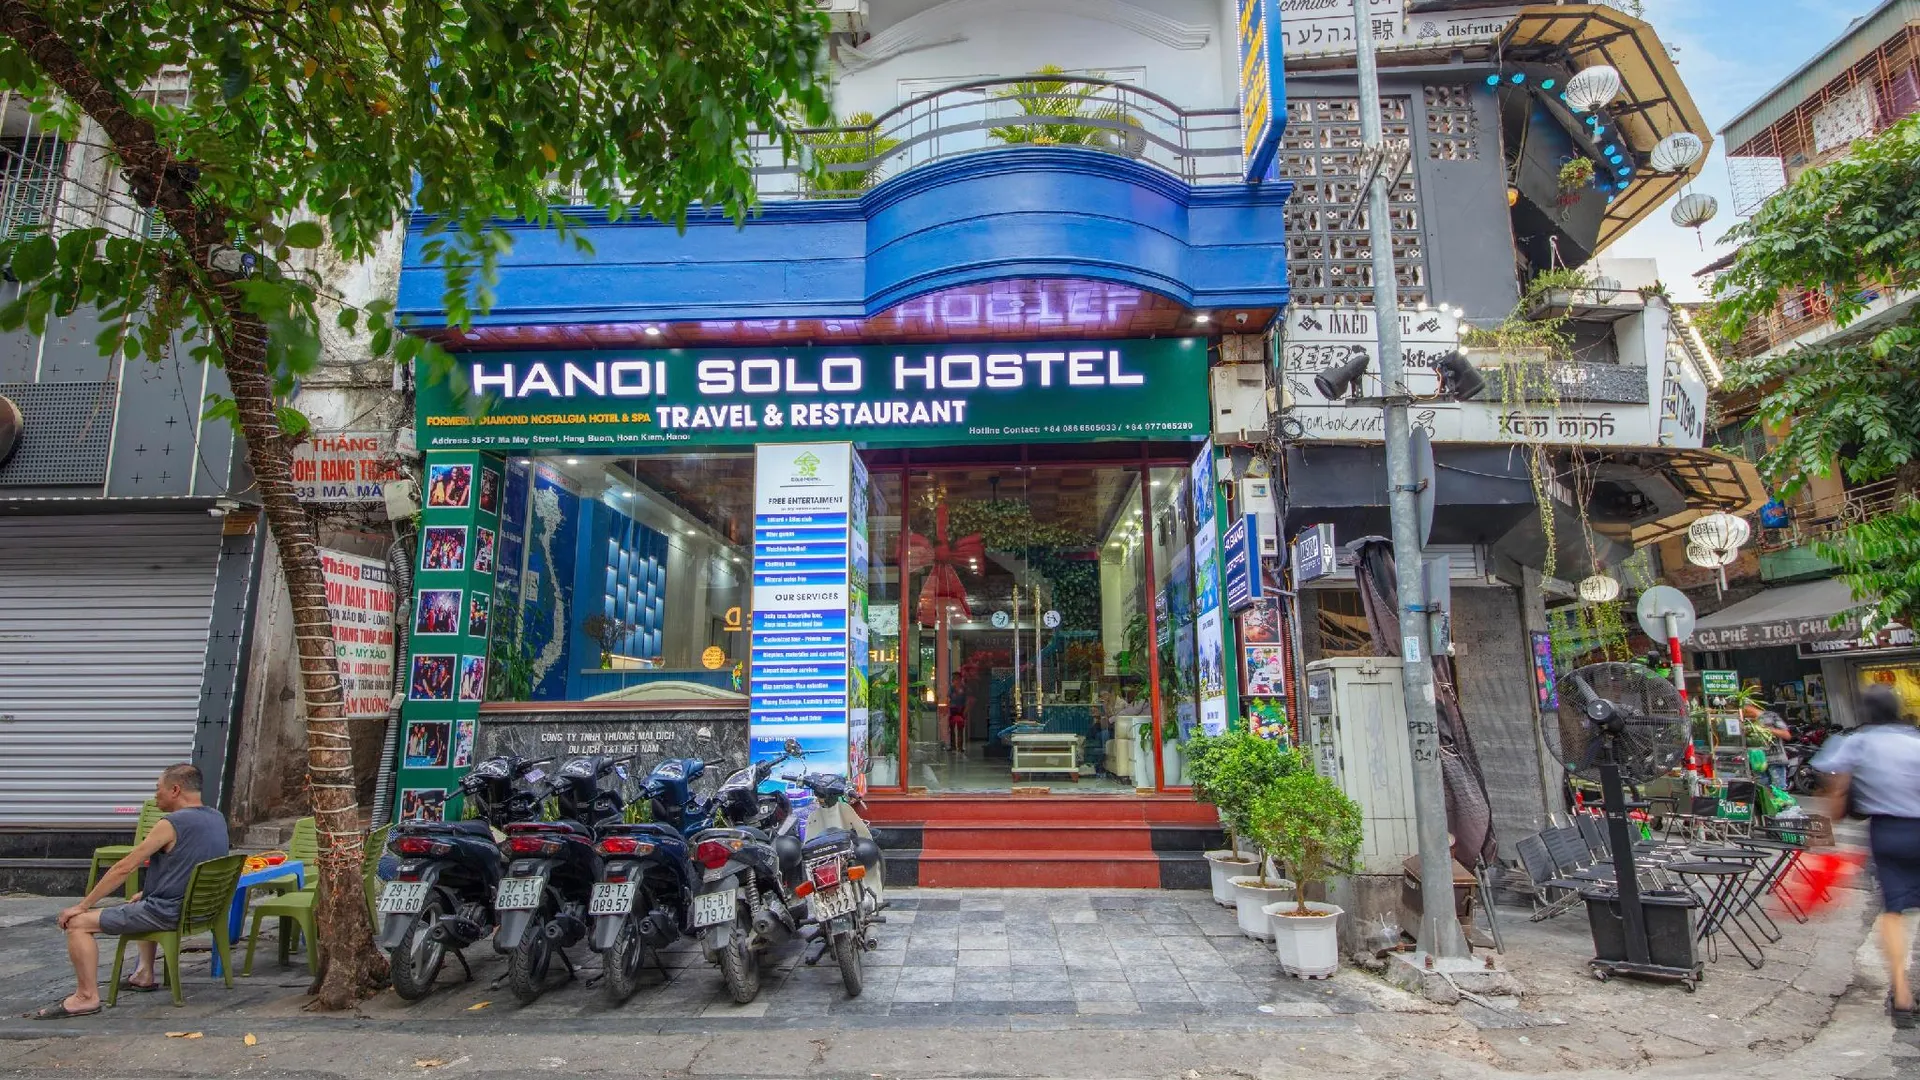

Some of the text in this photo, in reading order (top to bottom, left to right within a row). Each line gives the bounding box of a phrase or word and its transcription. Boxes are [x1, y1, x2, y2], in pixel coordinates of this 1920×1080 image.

[1447, 22, 1503, 37] disfruta
[473, 350, 1143, 397] HANOI SOLO HOSTEL
[480, 416, 528, 425] DIAMOND
[531, 414, 586, 425] NOSTALGIA
[589, 413, 620, 423] HOTEL
[622, 413, 629, 423] &
[632, 413, 651, 423] SPA
[656, 400, 966, 428] TRAVEL & RESTAURANT
[767, 497, 786, 505] FREE
[796, 592, 839, 600] SERVICES
[567, 733, 577, 742] TY
[641, 743, 659, 753] NAM
[389, 884, 421, 897] 29-Y7
[505, 881, 535, 894] 37-E1
[599, 884, 628, 898] 29-T2
[381, 898, 420, 911] 710.60
[499, 894, 535, 907] 865.52
[592, 898, 629, 912] 089.57
[703, 893, 729, 909] 15-B1
[697, 906, 733, 926] 219.72
